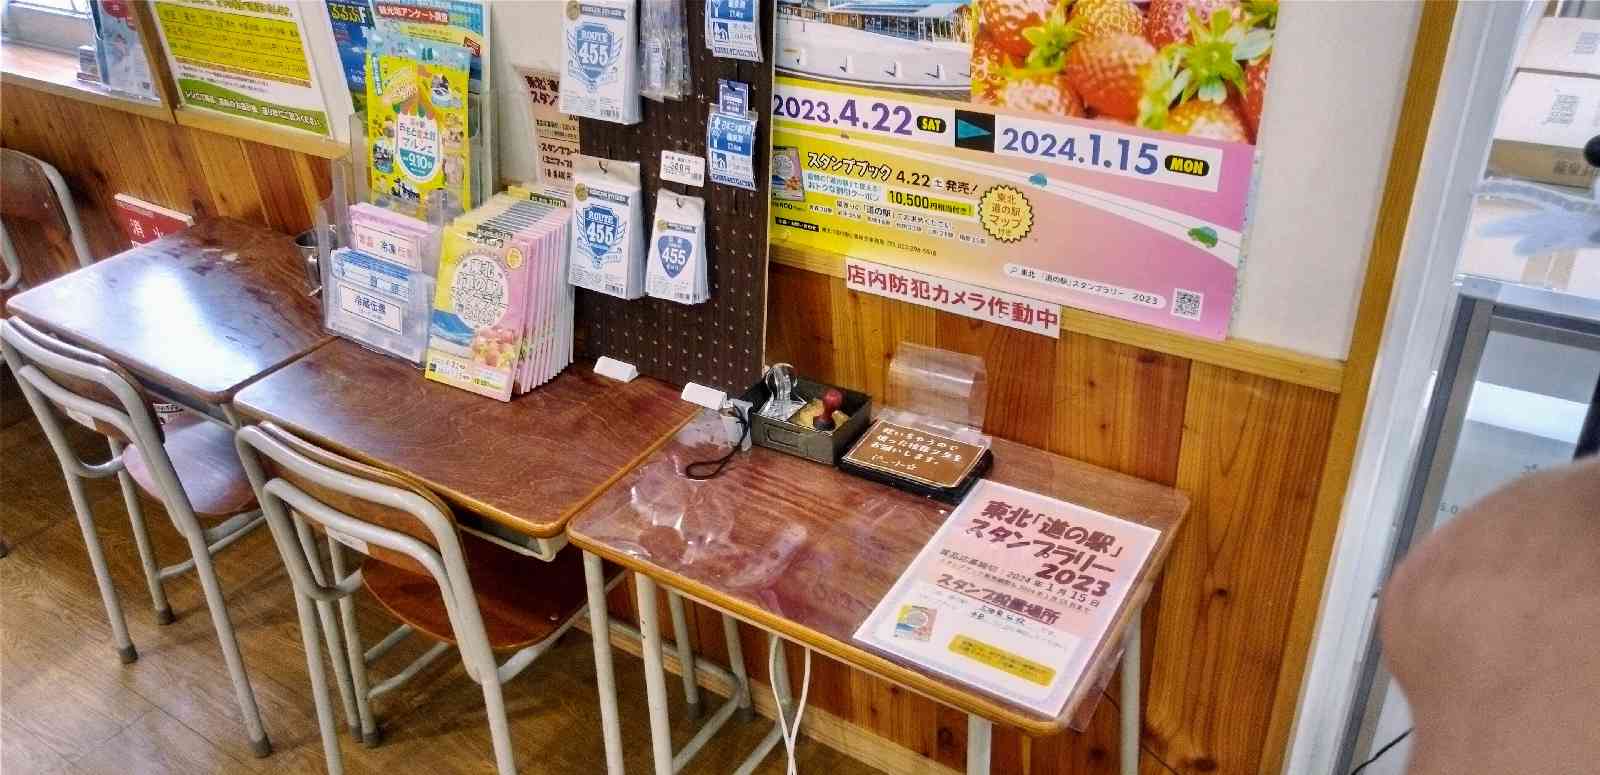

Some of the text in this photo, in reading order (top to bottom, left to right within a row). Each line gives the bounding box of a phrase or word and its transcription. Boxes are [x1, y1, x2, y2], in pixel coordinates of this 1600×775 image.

[578, 42, 609, 65] 455
[773, 94, 914, 136] 2023.4.22
[920, 116, 943, 132] SAT
[807, 151, 892, 181] スタンプブック
[896, 170, 931, 188] 4.22
[1003, 127, 1206, 176] 2024.1.15 MON
[588, 210, 615, 224] ROUTE
[990, 216, 1022, 229] マップ
[991, 203, 1021, 217] 道の駅
[586, 222, 615, 246] 455
[661, 247, 686, 265] 455
[846, 263, 1059, 332] 店内防犯カメラ作動中
[1020, 268, 1036, 279] 東北
[1132, 293, 1158, 305] 2023
[965, 518, 1116, 573] スタンプラリー
[981, 499, 1124, 558] 東北「道の駅」
[1035, 563, 1111, 597] 2023
[935, 573, 1060, 626] スタンプ設置場所
